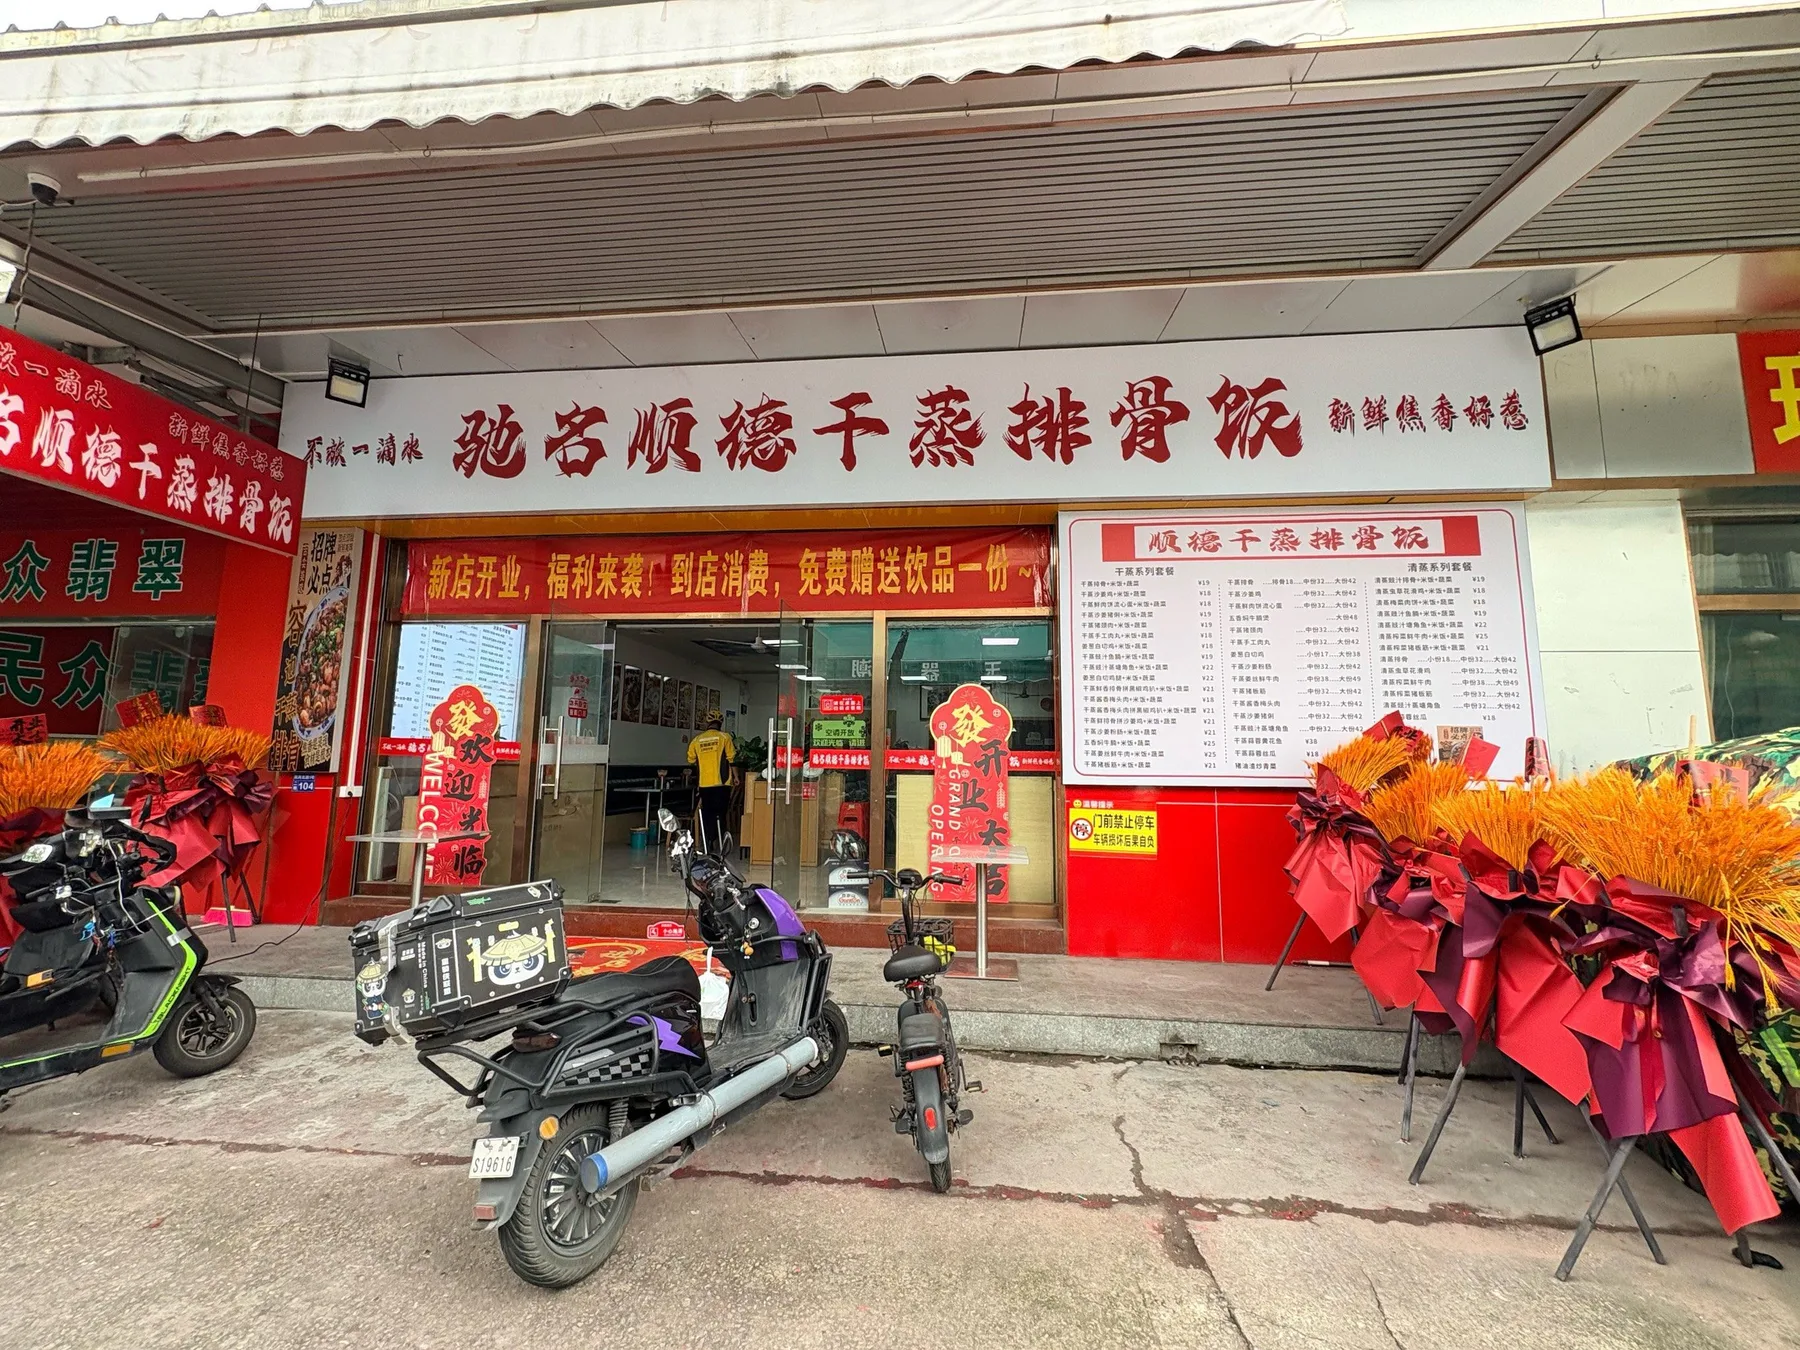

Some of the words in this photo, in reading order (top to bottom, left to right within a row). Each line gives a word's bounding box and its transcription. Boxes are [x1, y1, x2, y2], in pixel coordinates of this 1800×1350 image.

[453, 375, 1304, 478] 驰名顺德干蒸排骨饭
[1148, 525, 1430, 554] 顺德干蒸排骨饭
[1115, 567, 1174, 576] 干蒸系列套餐
[1408, 562, 1472, 572] 清蒸系列套餐
[299, 782, 314, 791] 104
[948, 768, 961, 831] GRAND
[1093, 813, 1155, 831] 门前禁止停车
[1093, 833, 1155, 848] 车辆损坏后果自负
[472, 1156, 513, 1173] S19616
